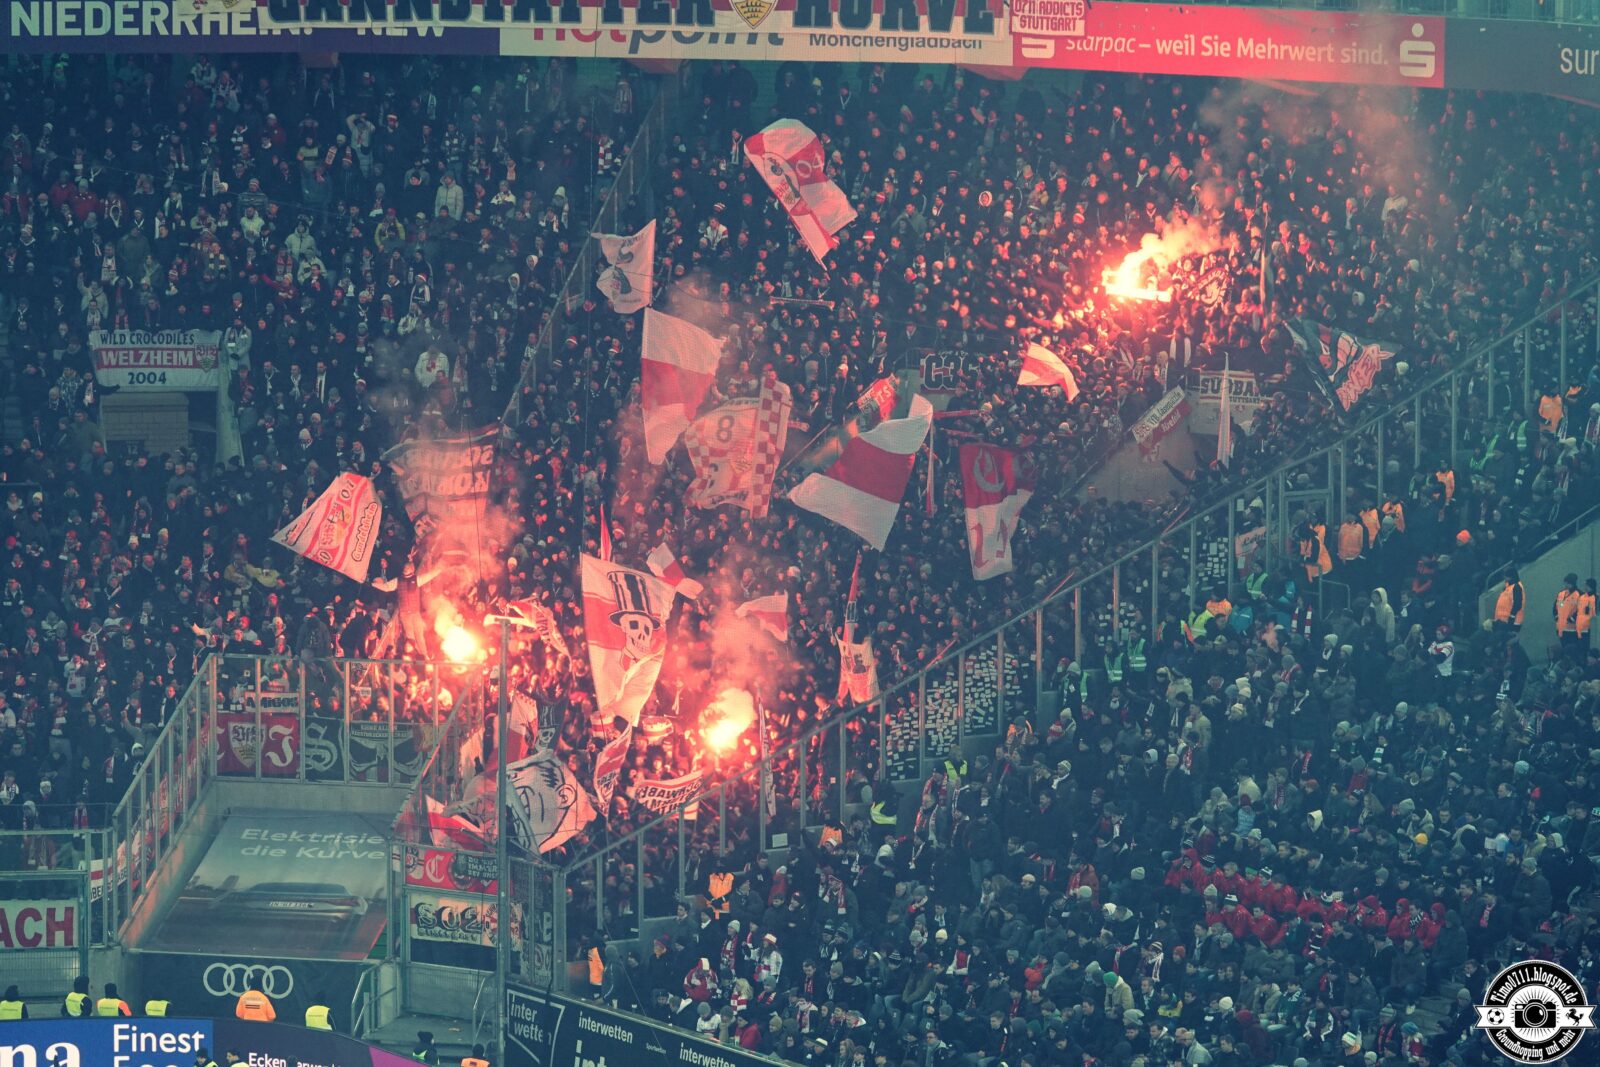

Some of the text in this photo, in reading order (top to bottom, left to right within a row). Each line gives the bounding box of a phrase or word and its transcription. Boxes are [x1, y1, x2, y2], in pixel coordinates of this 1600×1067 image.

[1019, 14, 1077, 32] STUTTGART
[1156, 34, 1196, 57] weil
[1200, 36, 1232, 57] Sie
[1236, 37, 1335, 63] Mehrwert
[1340, 42, 1389, 65] sind.
[101, 332, 195, 345] WILD CROCODILES
[101, 349, 194, 366] WELZHEIM
[127, 371, 167, 385] 2004
[240, 844, 385, 859] die Kurve
[510, 994, 538, 1022] inter
[578, 1010, 633, 1044] interwetten
[113, 1023, 205, 1054] Finest
